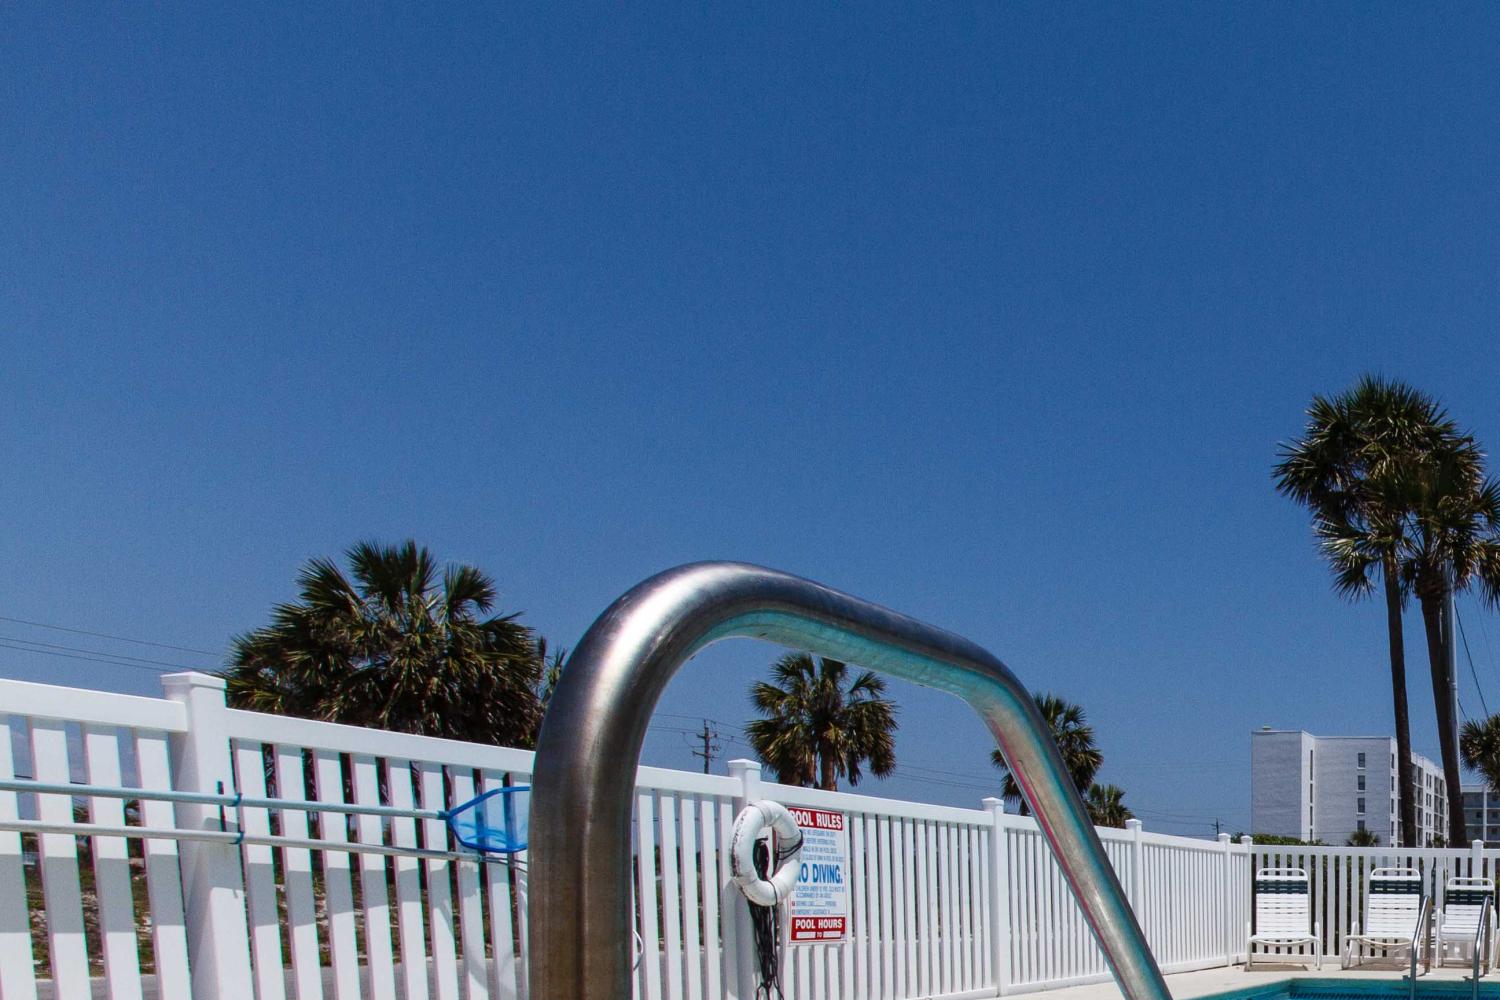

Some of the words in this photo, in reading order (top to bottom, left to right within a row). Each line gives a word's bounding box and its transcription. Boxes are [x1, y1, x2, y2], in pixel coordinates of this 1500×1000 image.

[816, 812, 842, 829] RULES
[812, 864, 843, 884] DIVING.
[795, 919, 816, 929] POOL
[818, 919, 842, 929] HOURS
